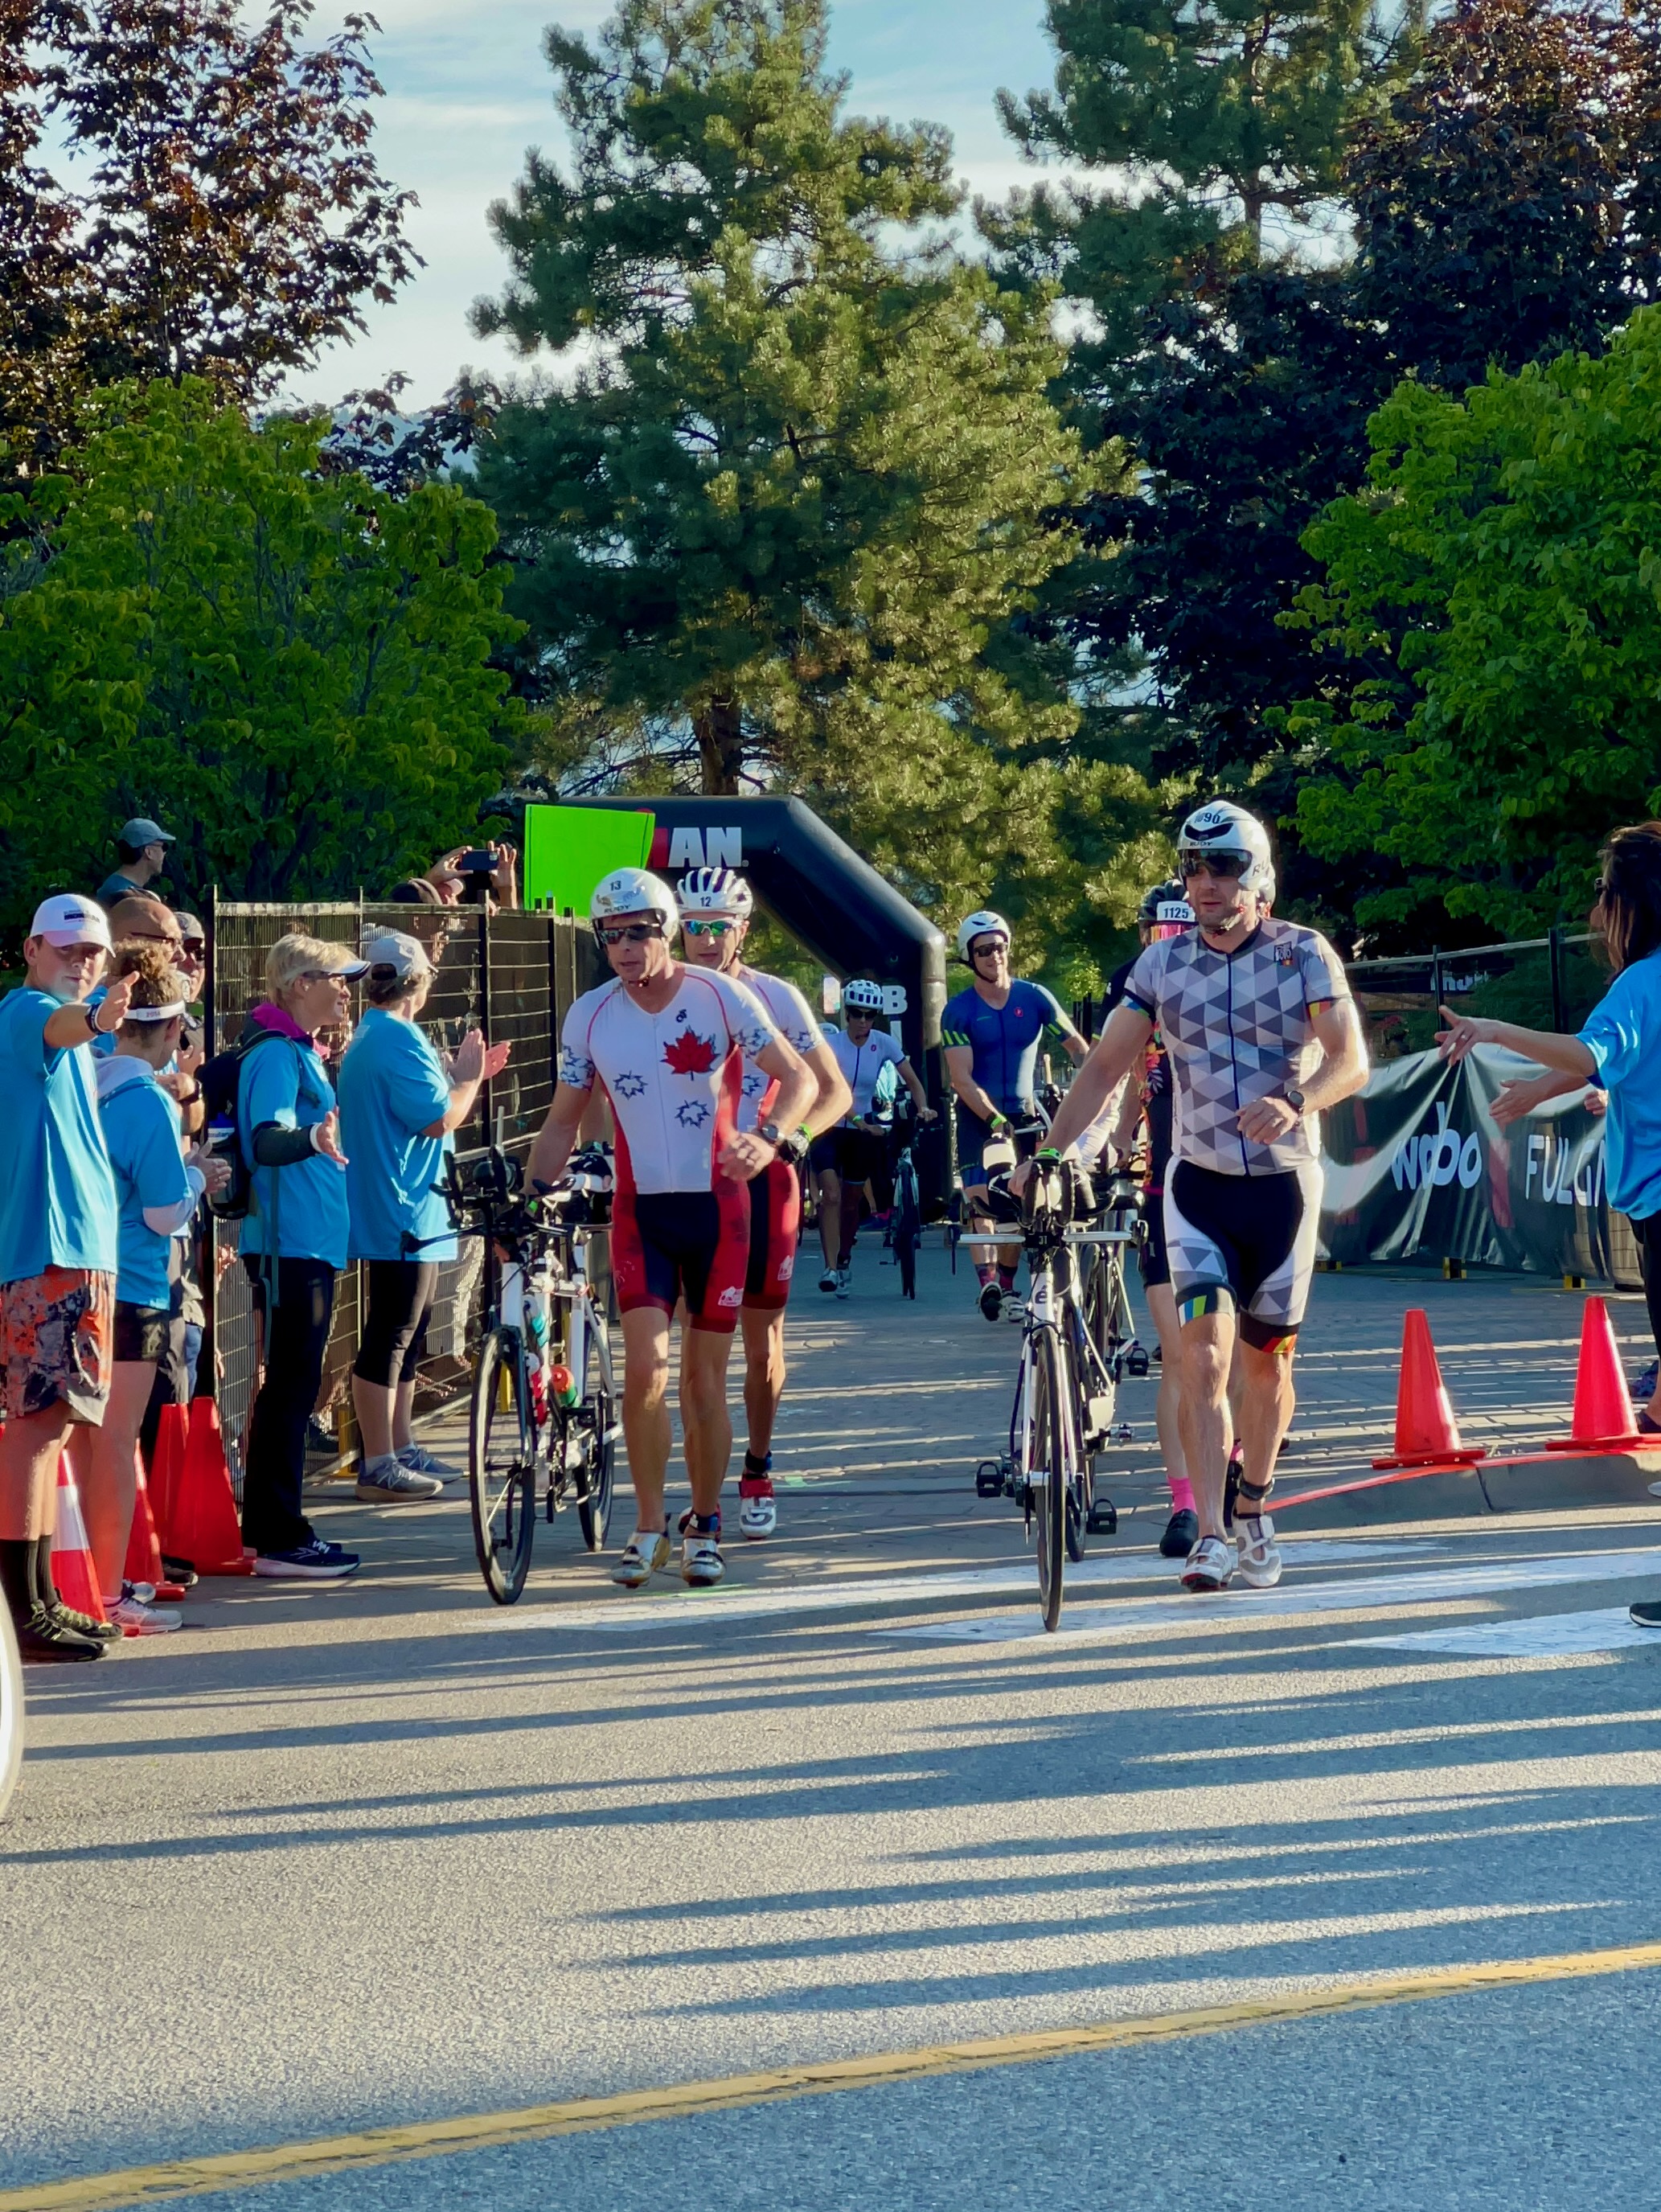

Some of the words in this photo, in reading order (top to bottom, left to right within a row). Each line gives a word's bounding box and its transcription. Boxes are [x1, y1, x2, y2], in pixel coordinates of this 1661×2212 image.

[653, 827, 742, 868] AN
[610, 880, 621, 891] 13
[700, 896, 712, 907] 12
[1164, 907, 1189, 919] 1125
